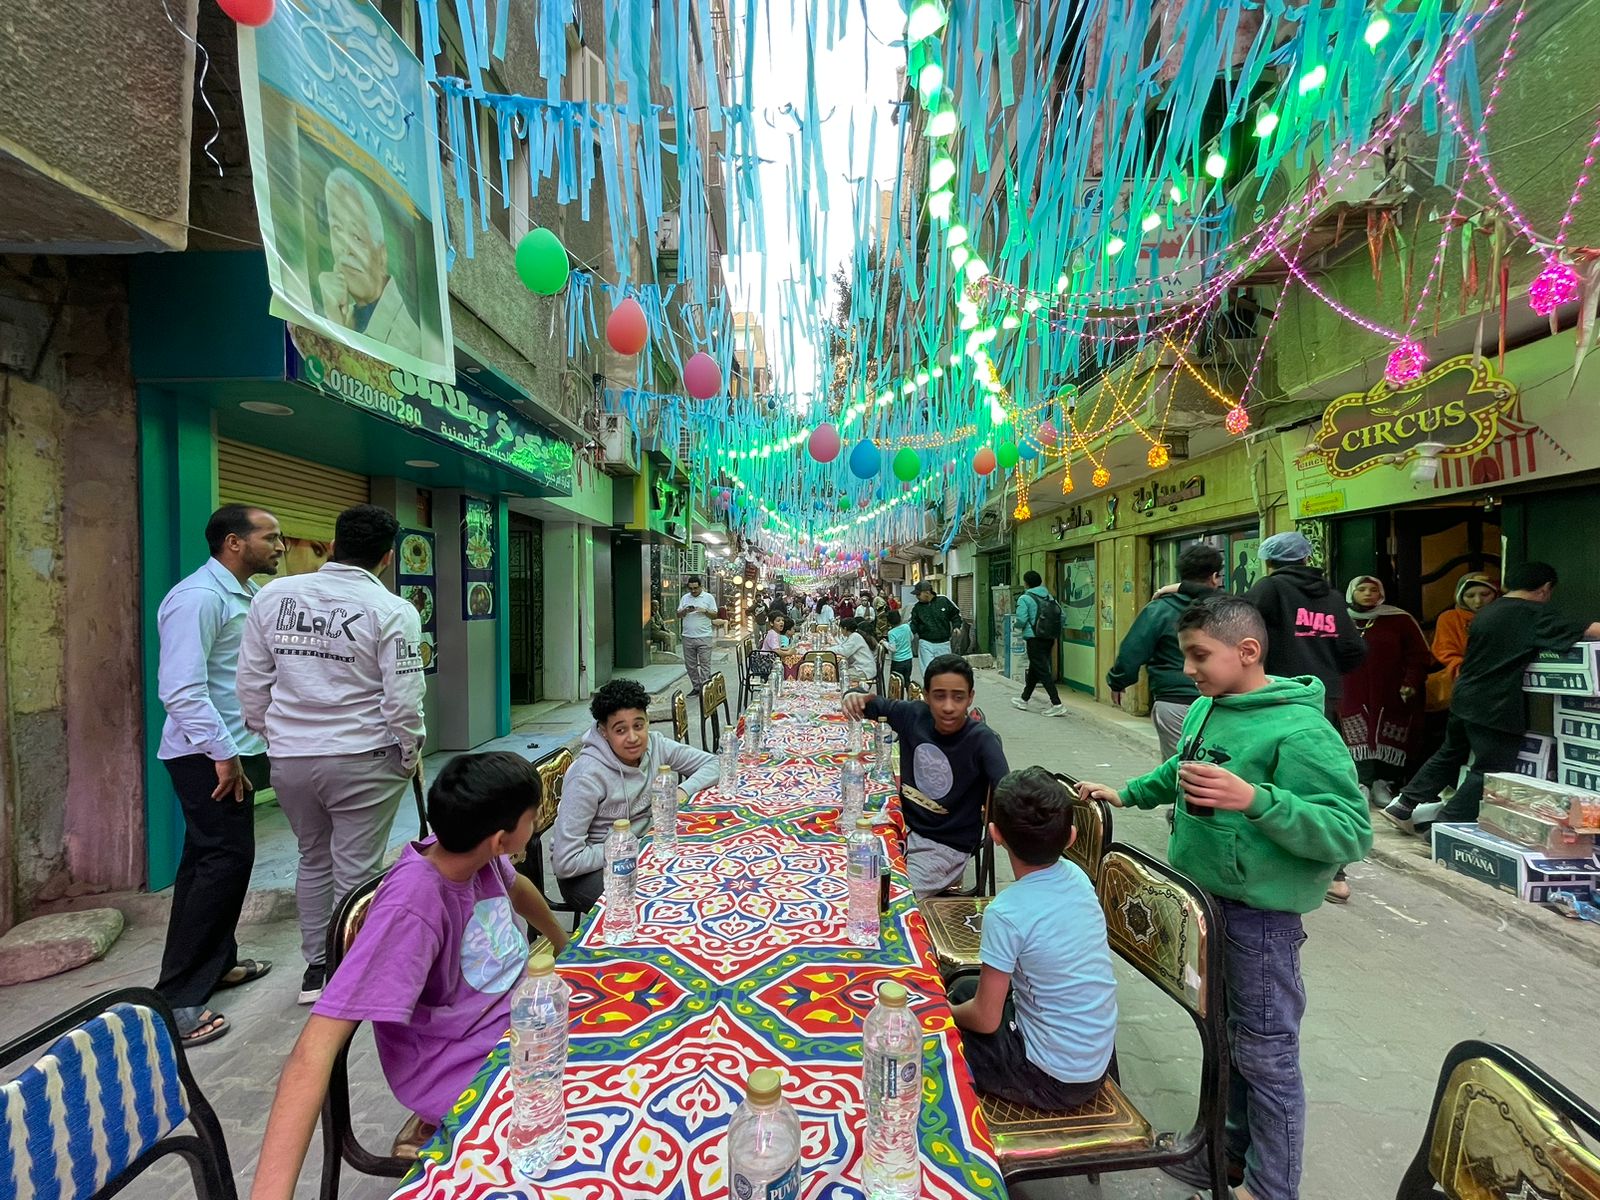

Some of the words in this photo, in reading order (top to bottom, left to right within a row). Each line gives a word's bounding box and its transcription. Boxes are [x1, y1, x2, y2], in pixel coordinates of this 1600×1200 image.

[300, 73, 356, 137] رمضان
[331, 369, 422, 426] 01120180280
[1341, 400, 1468, 452] CIRCUS
[1454, 849, 1496, 875] PUVANA
